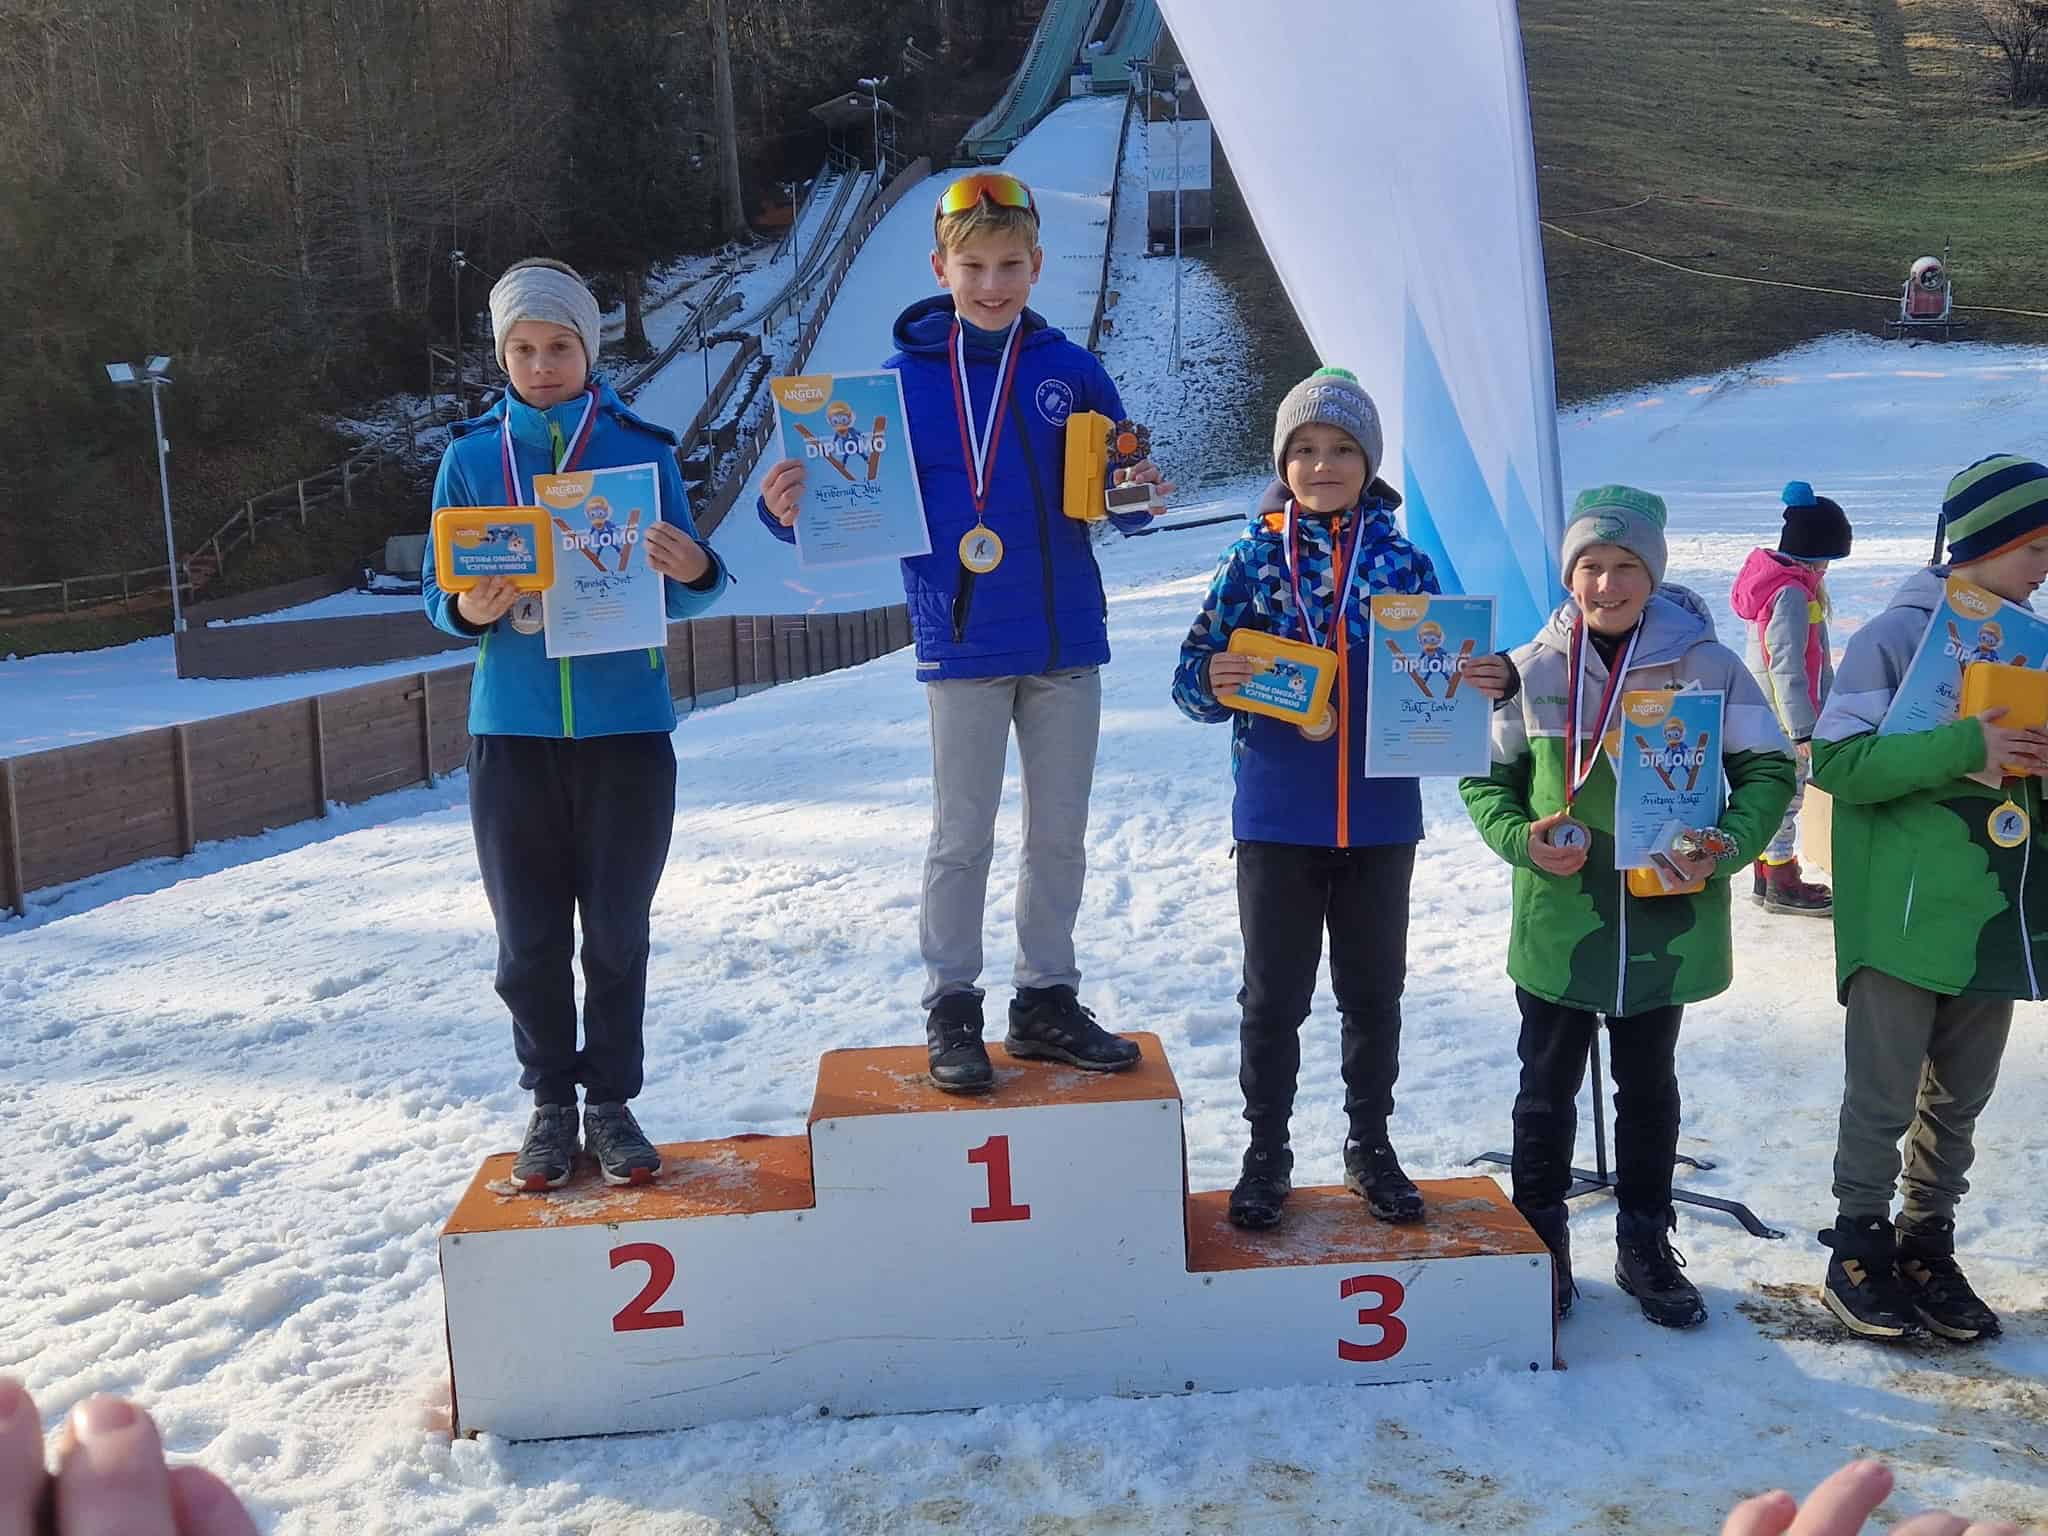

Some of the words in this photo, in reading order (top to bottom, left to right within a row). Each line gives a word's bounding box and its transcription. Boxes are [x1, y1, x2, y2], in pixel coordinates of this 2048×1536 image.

[784, 387, 824, 401] ARGETA
[806, 437, 887, 458] DIPLOMO
[563, 530, 639, 551] DIPLOMO
[1381, 607, 1418, 619] ARGETA
[1631, 703, 1665, 716] ARGETA
[1639, 752, 1705, 767] DIPLOMO
[967, 1135, 1031, 1223] 1
[609, 1243, 684, 1332] 2
[1338, 1274, 1407, 1362] 3
